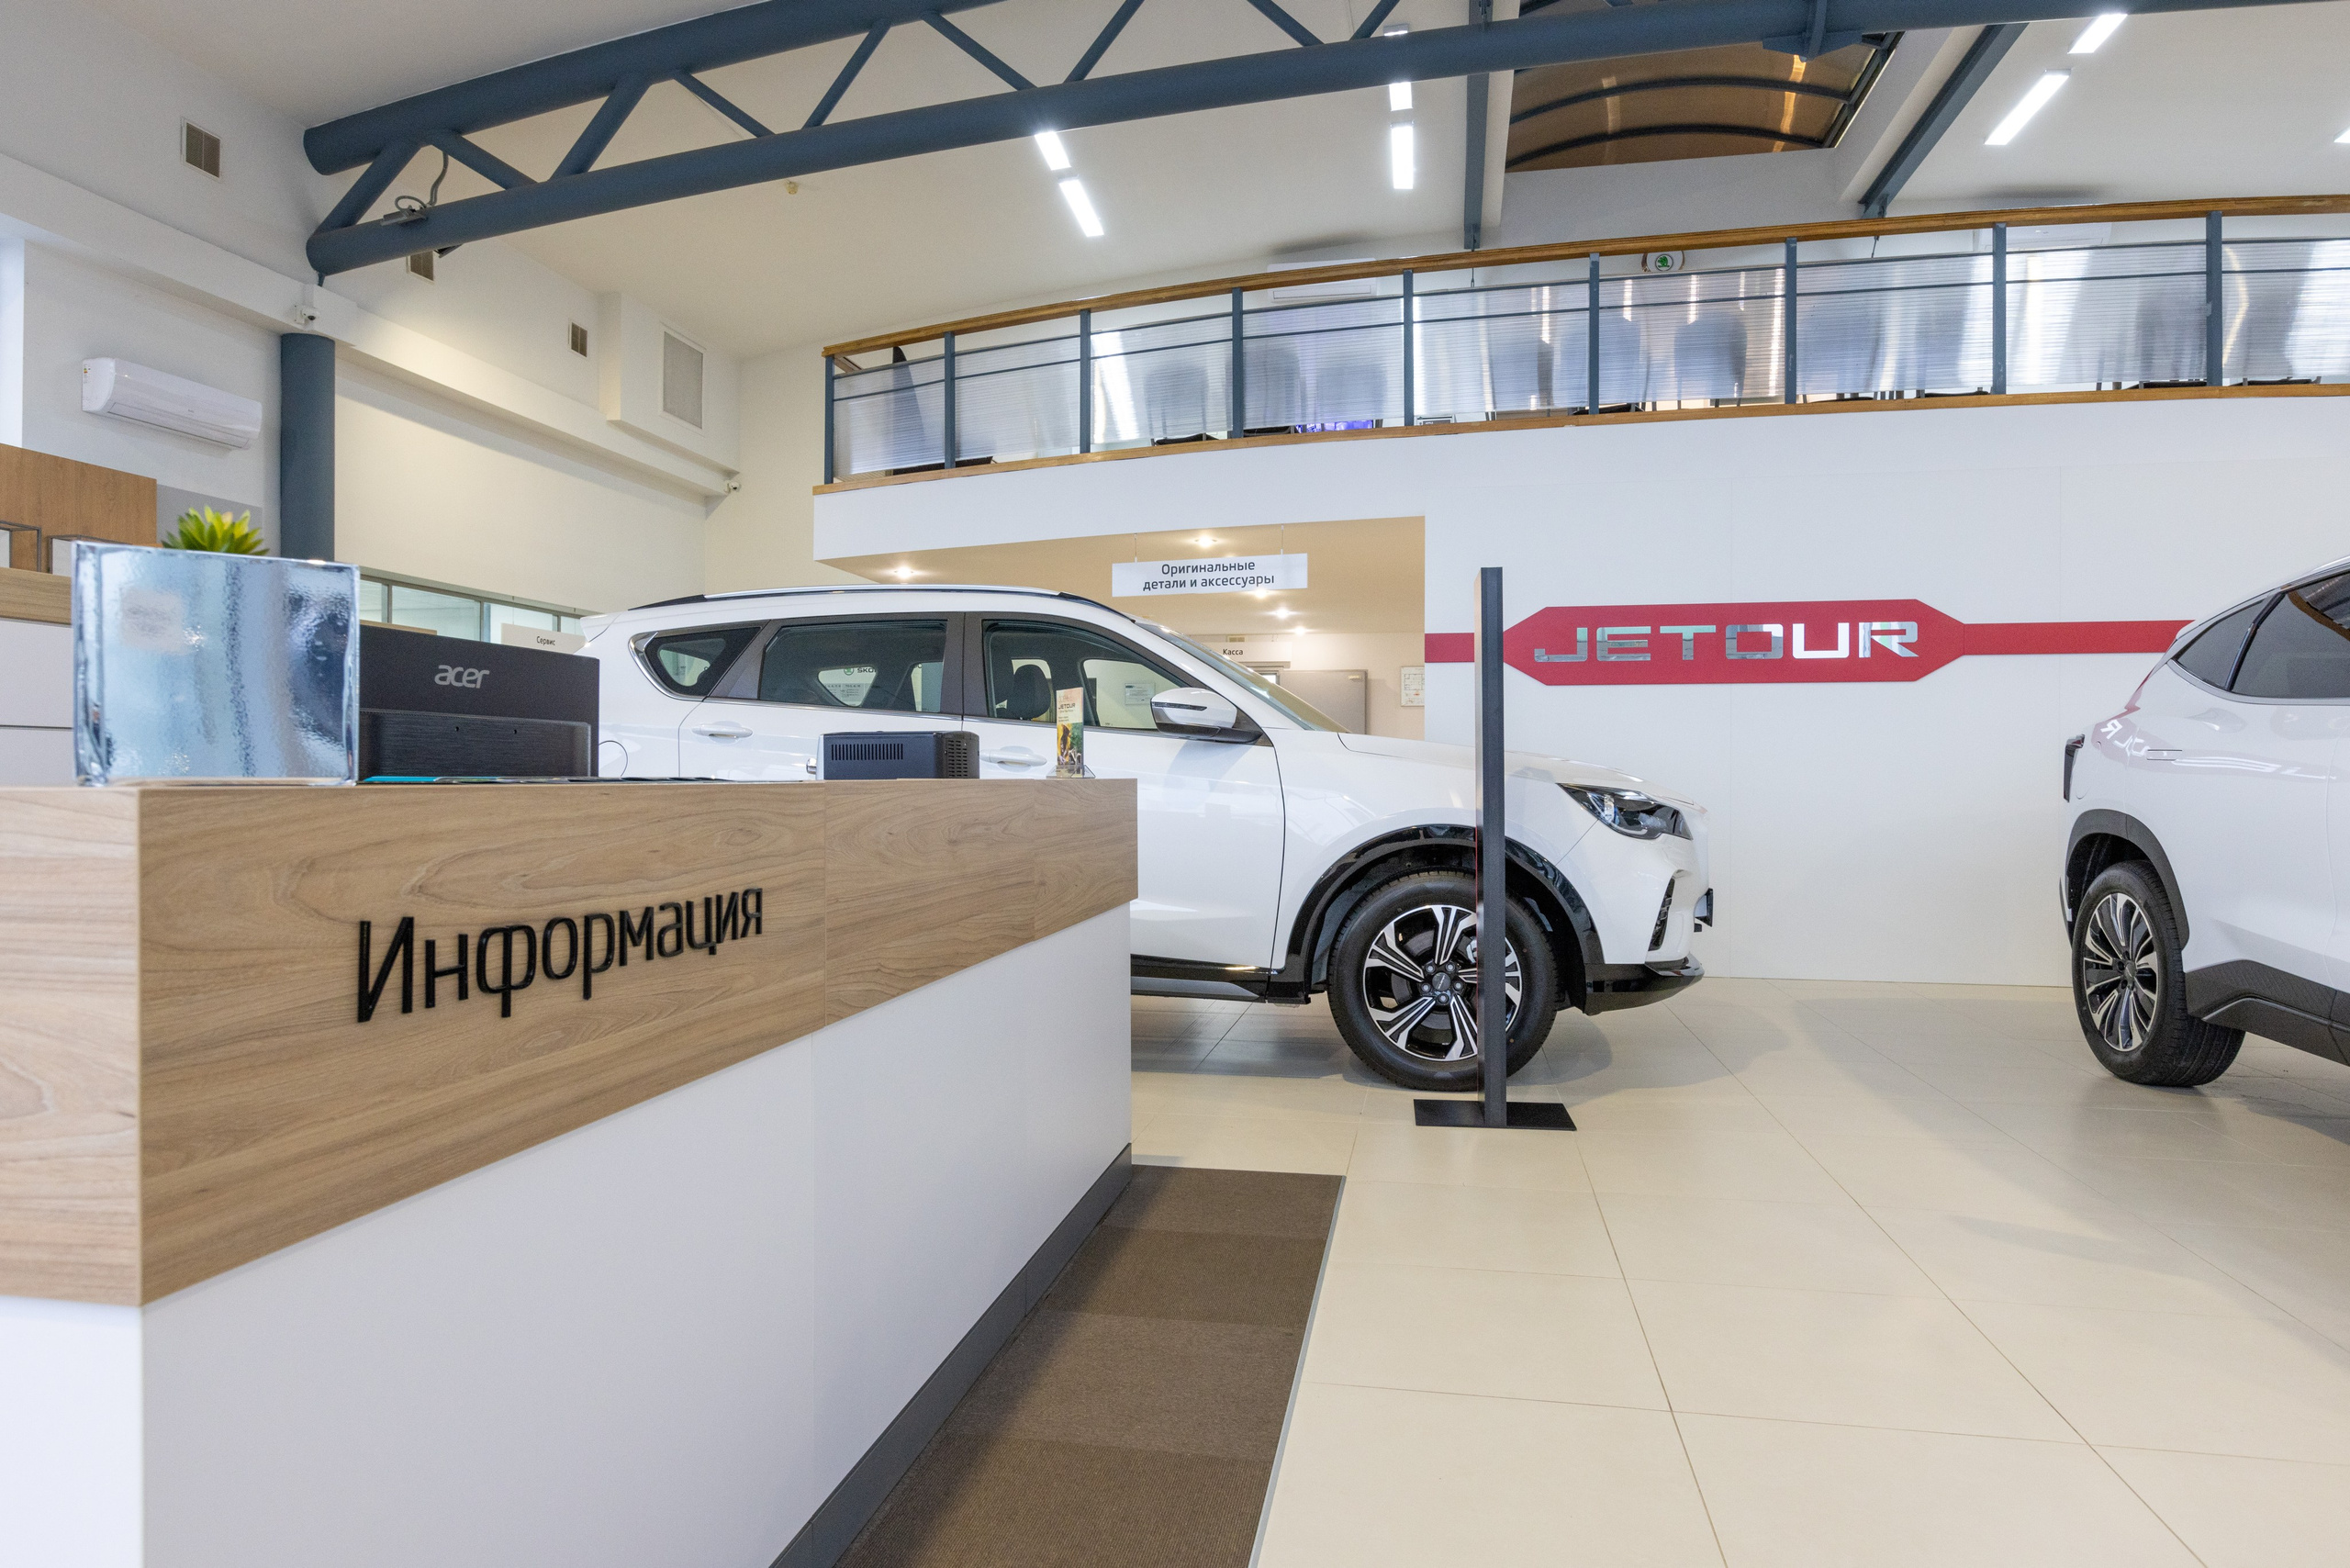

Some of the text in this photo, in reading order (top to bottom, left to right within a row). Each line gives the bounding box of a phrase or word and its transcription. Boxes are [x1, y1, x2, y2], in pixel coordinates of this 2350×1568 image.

[1161, 562, 1255, 577] Оригинальные
[1143, 574, 1275, 591] детали и аксессуары
[537, 636, 555, 645] Сервис
[1534, 621, 1919, 662] JETOUR
[434, 664, 489, 689] acer
[356, 887, 764, 1023] Информация
